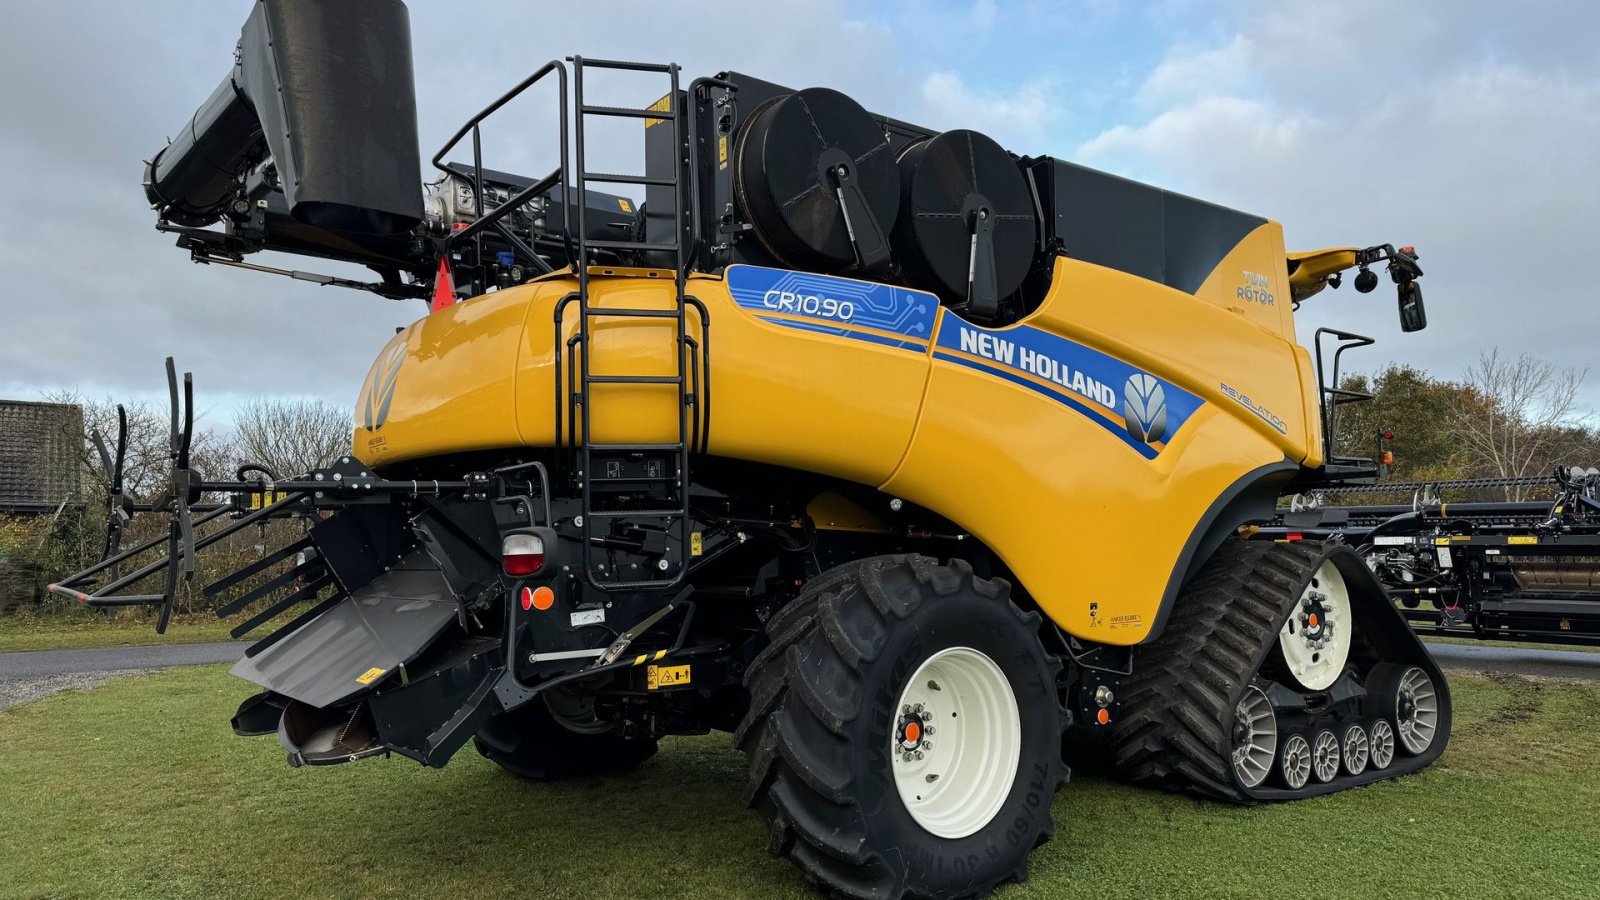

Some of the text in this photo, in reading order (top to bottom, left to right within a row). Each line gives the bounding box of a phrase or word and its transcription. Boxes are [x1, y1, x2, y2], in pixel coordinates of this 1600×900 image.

[1243, 270, 1268, 288] TWIN
[763, 290, 854, 320] CR10.90
[1237, 285, 1275, 306] ROTOR
[960, 327, 1116, 409] NEW HOLLAND
[1220, 382, 1288, 431] REVELATION
